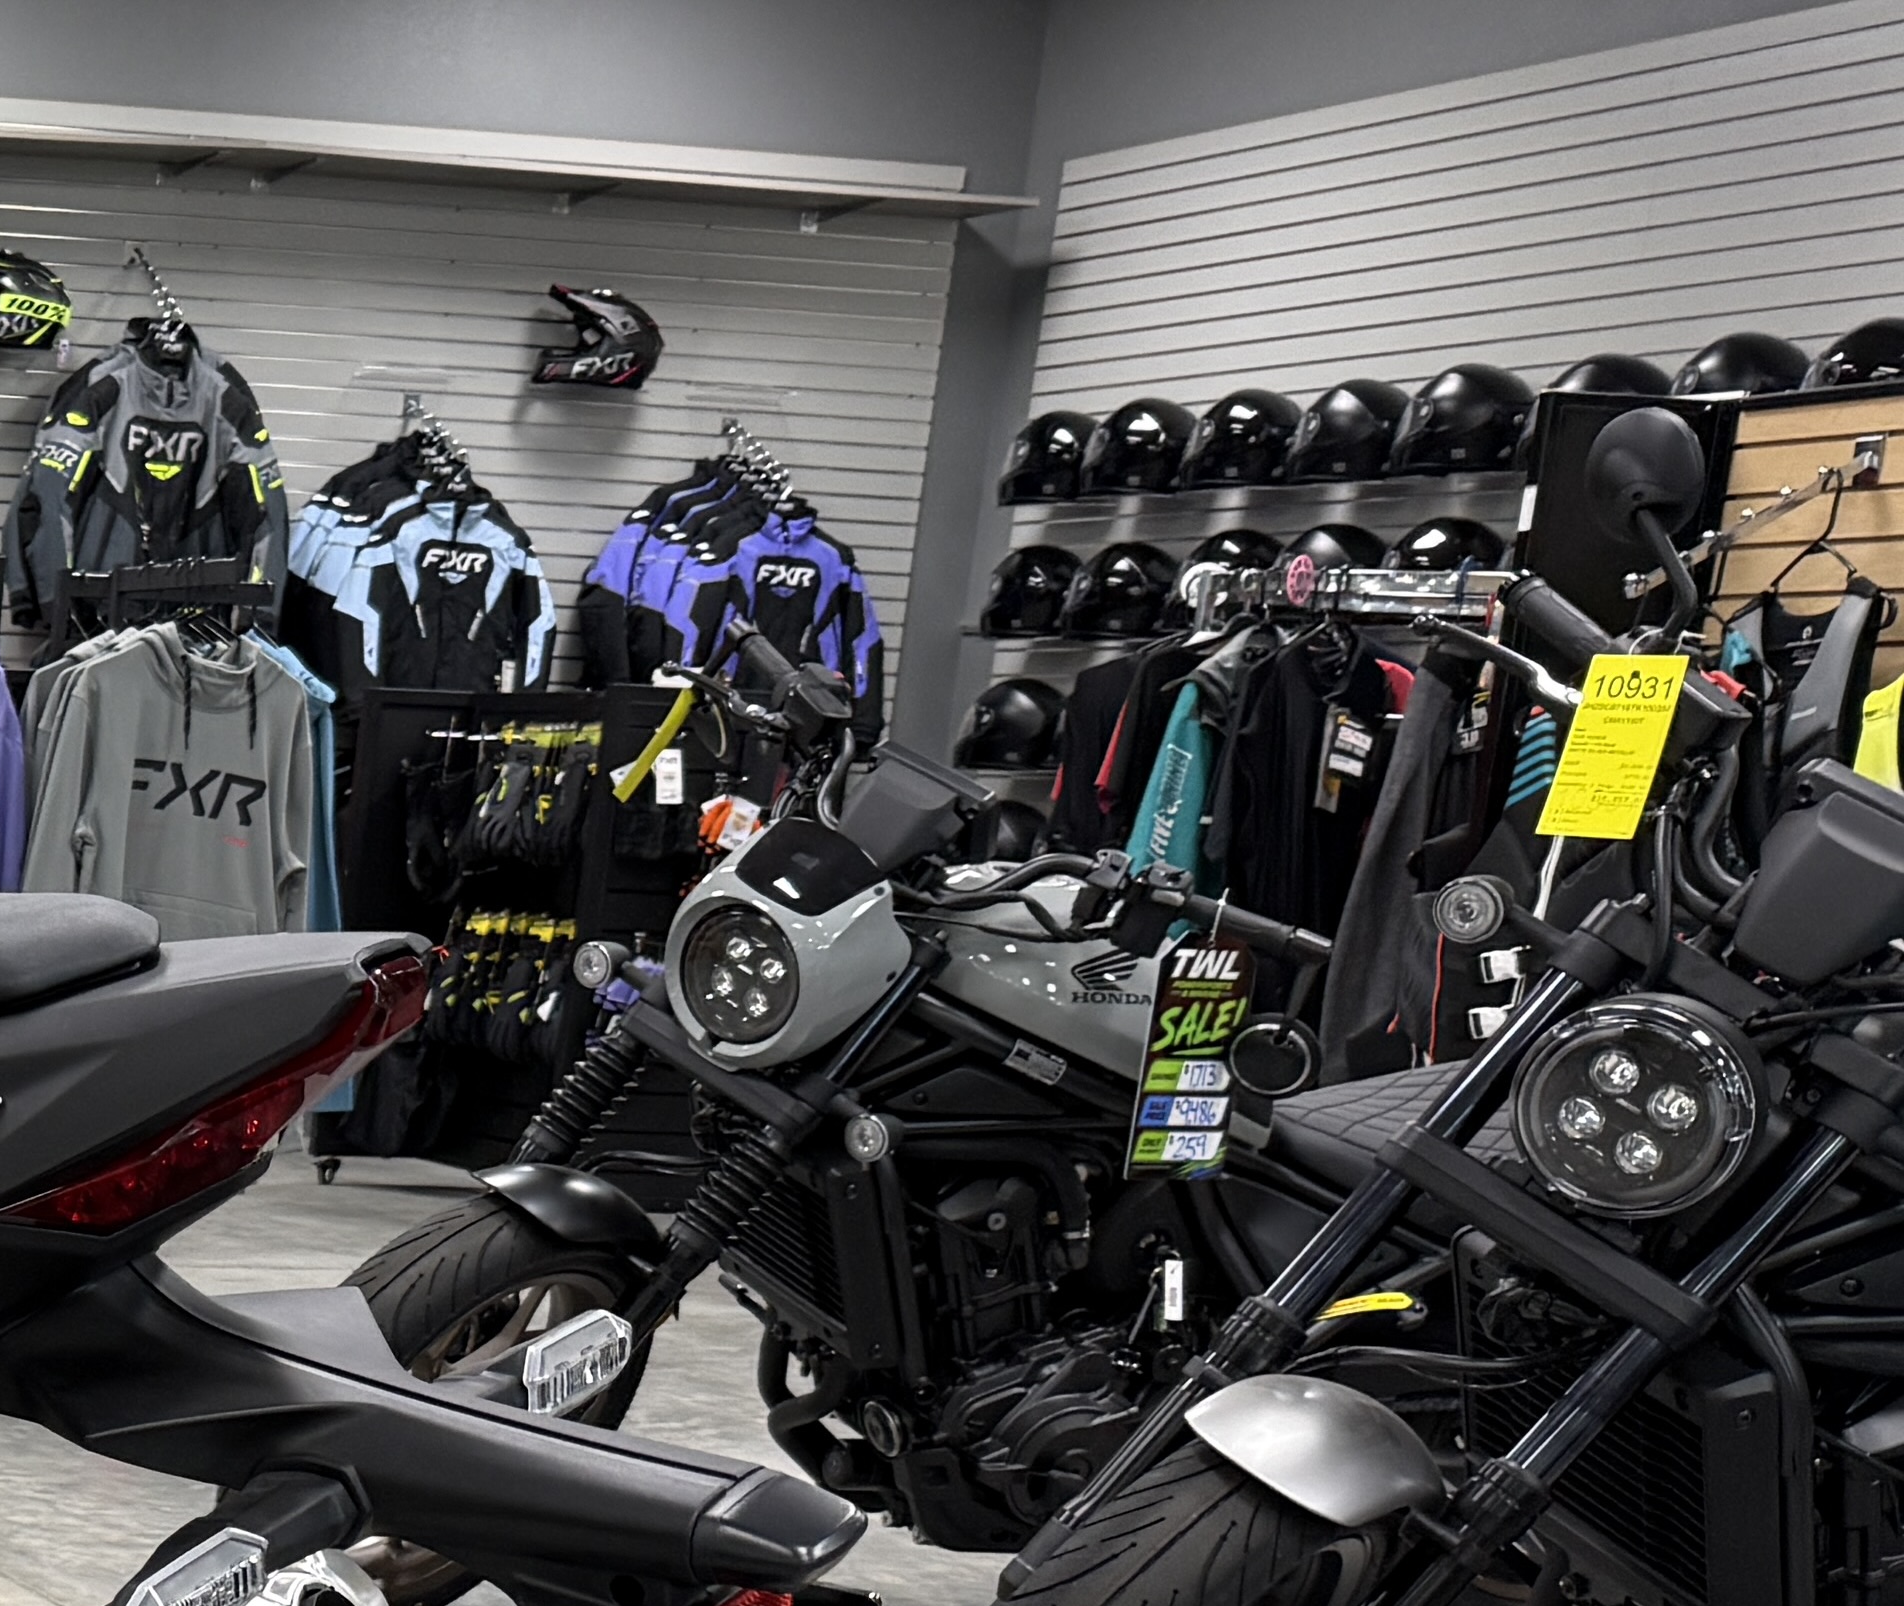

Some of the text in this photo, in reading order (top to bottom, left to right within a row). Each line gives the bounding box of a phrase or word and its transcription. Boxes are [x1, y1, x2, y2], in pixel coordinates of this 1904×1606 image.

[5, 297, 67, 322] 100%
[571, 351, 634, 379] FXR
[128, 424, 203, 463] FXR
[422, 547, 489, 574] FXR
[756, 564, 817, 587] FXR
[1594, 673, 1675, 700] 10931
[131, 758, 268, 828] FXR
[1171, 948, 1241, 981] TWL
[1071, 991, 1152, 1007] HONDA
[1150, 998, 1247, 1052] SALE!
